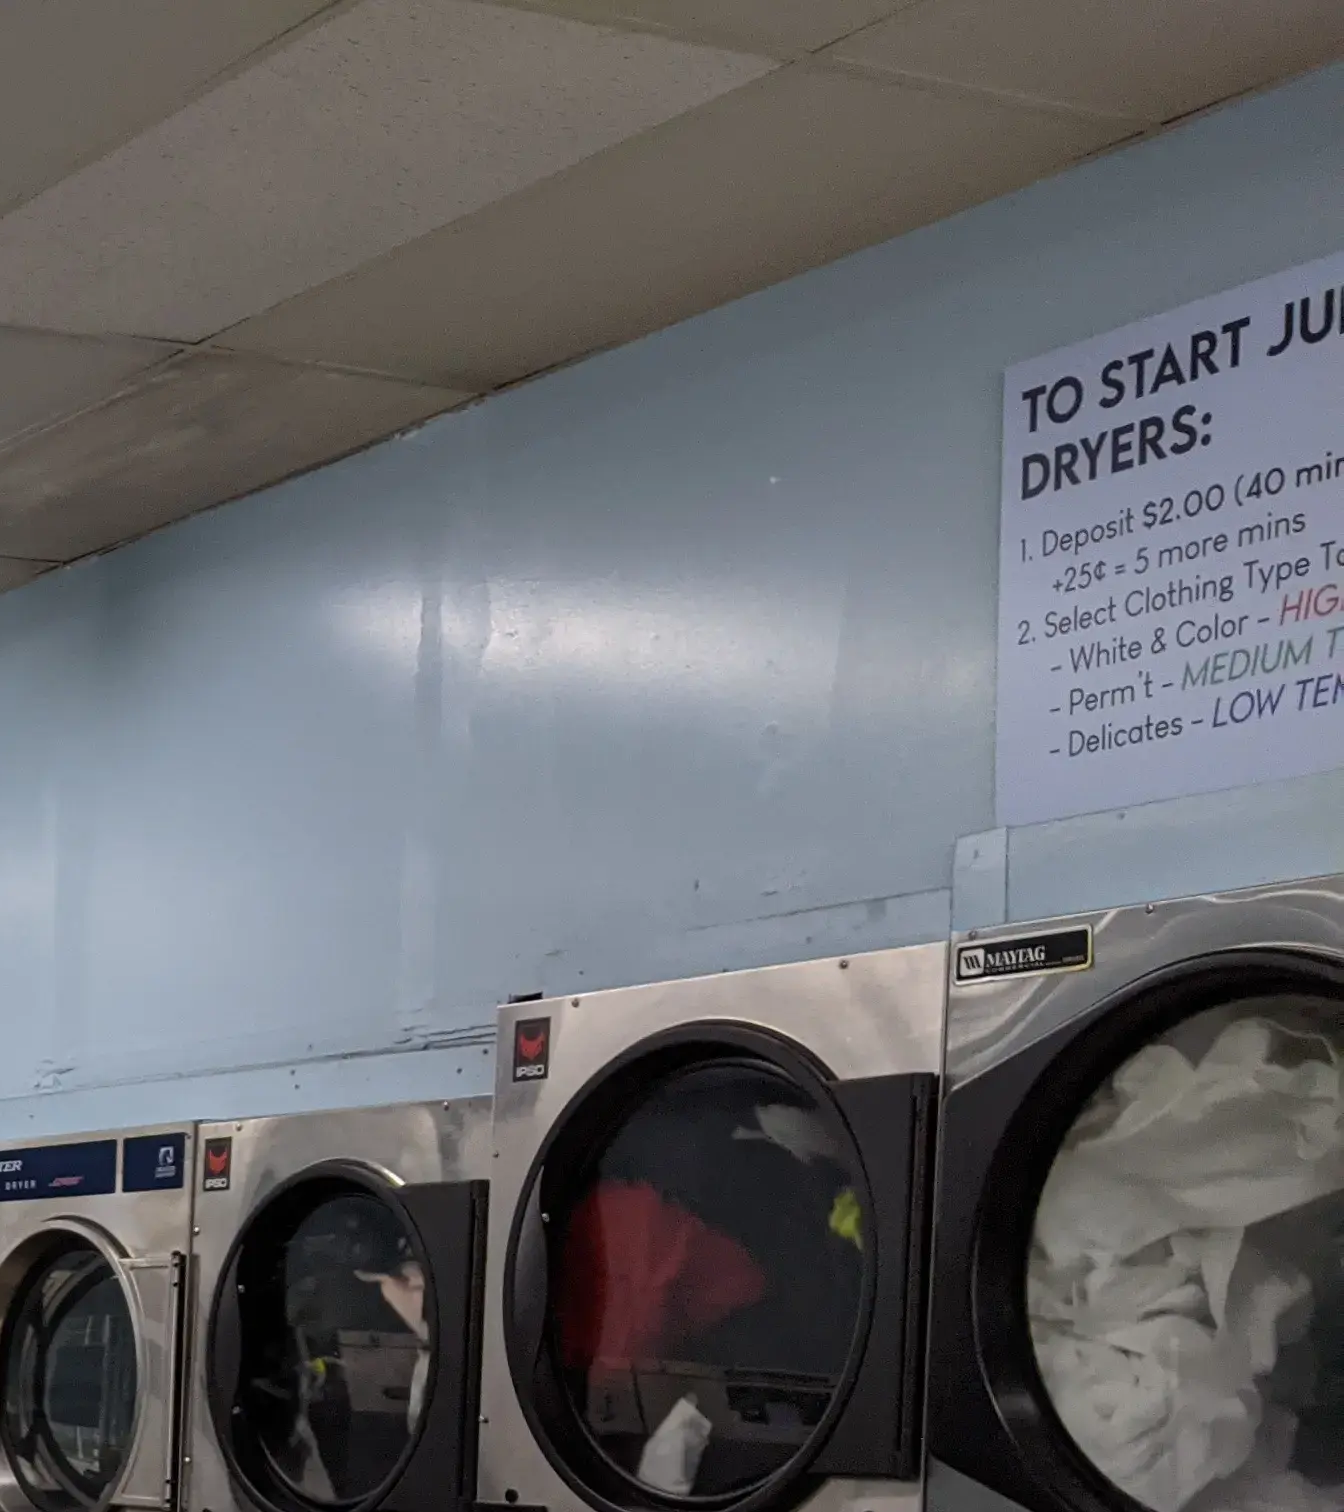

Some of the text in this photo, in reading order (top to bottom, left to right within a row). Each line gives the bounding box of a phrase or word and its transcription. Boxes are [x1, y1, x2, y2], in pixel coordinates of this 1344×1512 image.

[1021, 284, 1344, 434] TO START JU
[1020, 404, 1213, 501] DRYERS:
[1021, 538, 1033, 563] 1.
[1042, 507, 1134, 556] Deposit
[1142, 483, 1224, 530] $2.00
[1234, 467, 1286, 508] (40
[1052, 560, 1107, 593] +25¢
[1134, 546, 1149, 575] 5
[1158, 532, 1229, 569] more
[1238, 511, 1306, 548] mins
[1017, 619, 1037, 647] 2.
[1043, 596, 1117, 639] Select
[1125, 574, 1234, 617] Clothing
[1242, 556, 1312, 594] Type
[1069, 635, 1143, 674] White
[1150, 626, 1167, 655] &
[1175, 612, 1250, 648] Color
[1278, 583, 1344, 627] HIG
[1068, 670, 1154, 716] Perm't
[1180, 634, 1314, 692] MEDIUM
[1068, 714, 1184, 758] Delicates
[1212, 683, 1286, 729] LOW
[984, 945, 1046, 967] MAYTAG
[516, 1064, 545, 1078] IPSO
